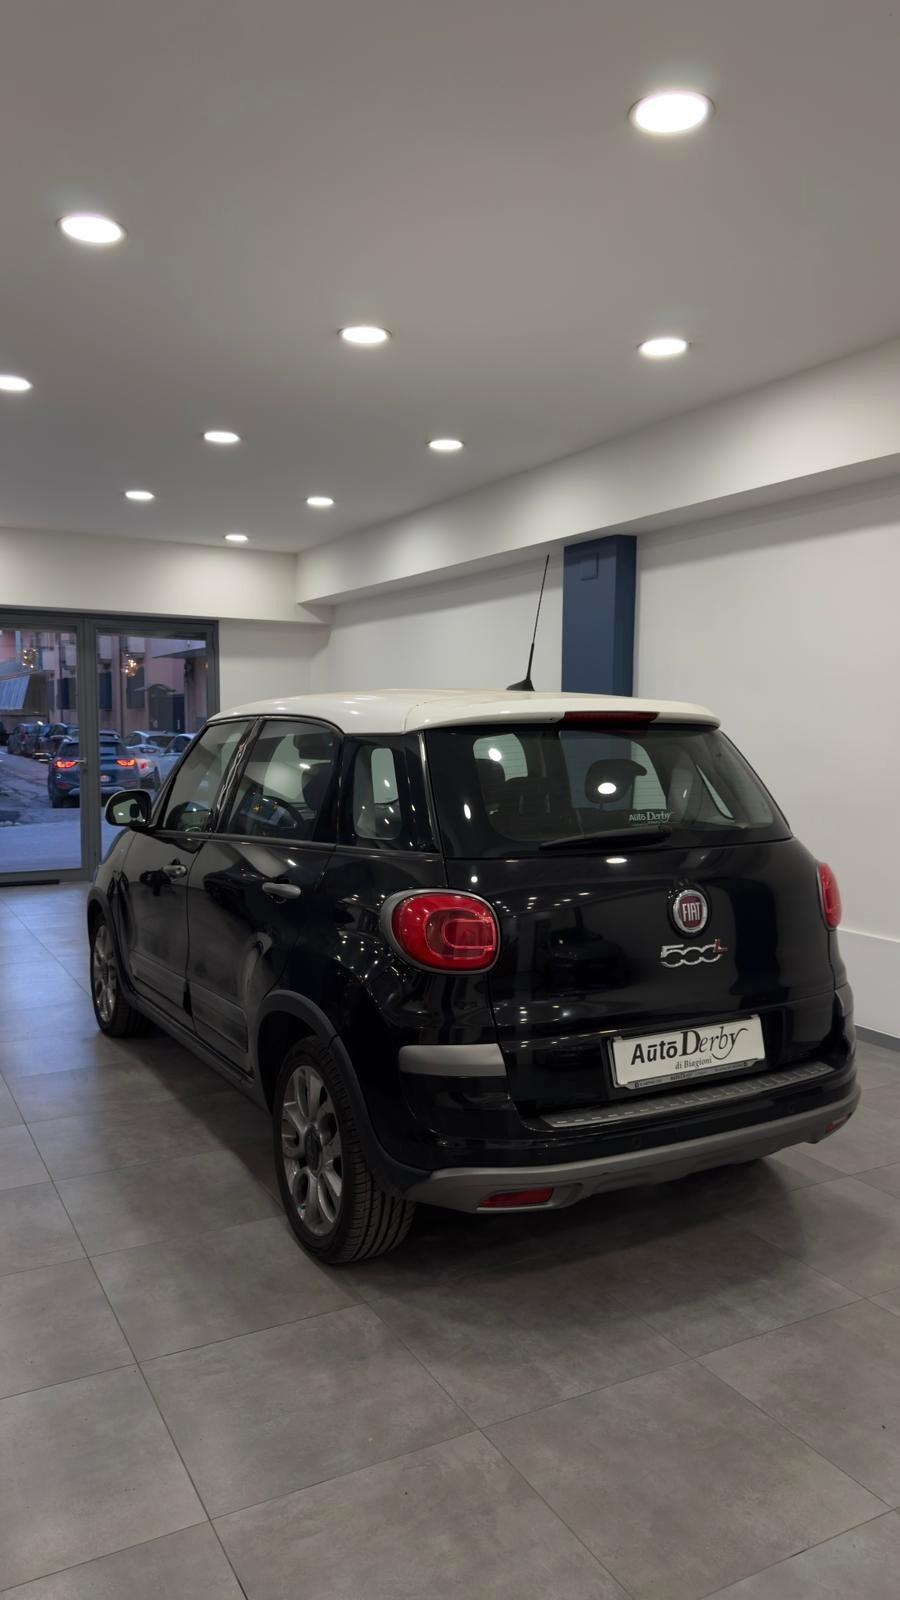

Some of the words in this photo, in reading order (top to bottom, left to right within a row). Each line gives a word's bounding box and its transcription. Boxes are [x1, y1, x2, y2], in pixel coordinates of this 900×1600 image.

[682, 902, 701, 922] FIAT
[660, 938, 728, 967] 500L
[679, 1026, 749, 1060] Derby
[675, 1061, 683, 1070] di
[684, 1058, 712, 1069] Biagioni
